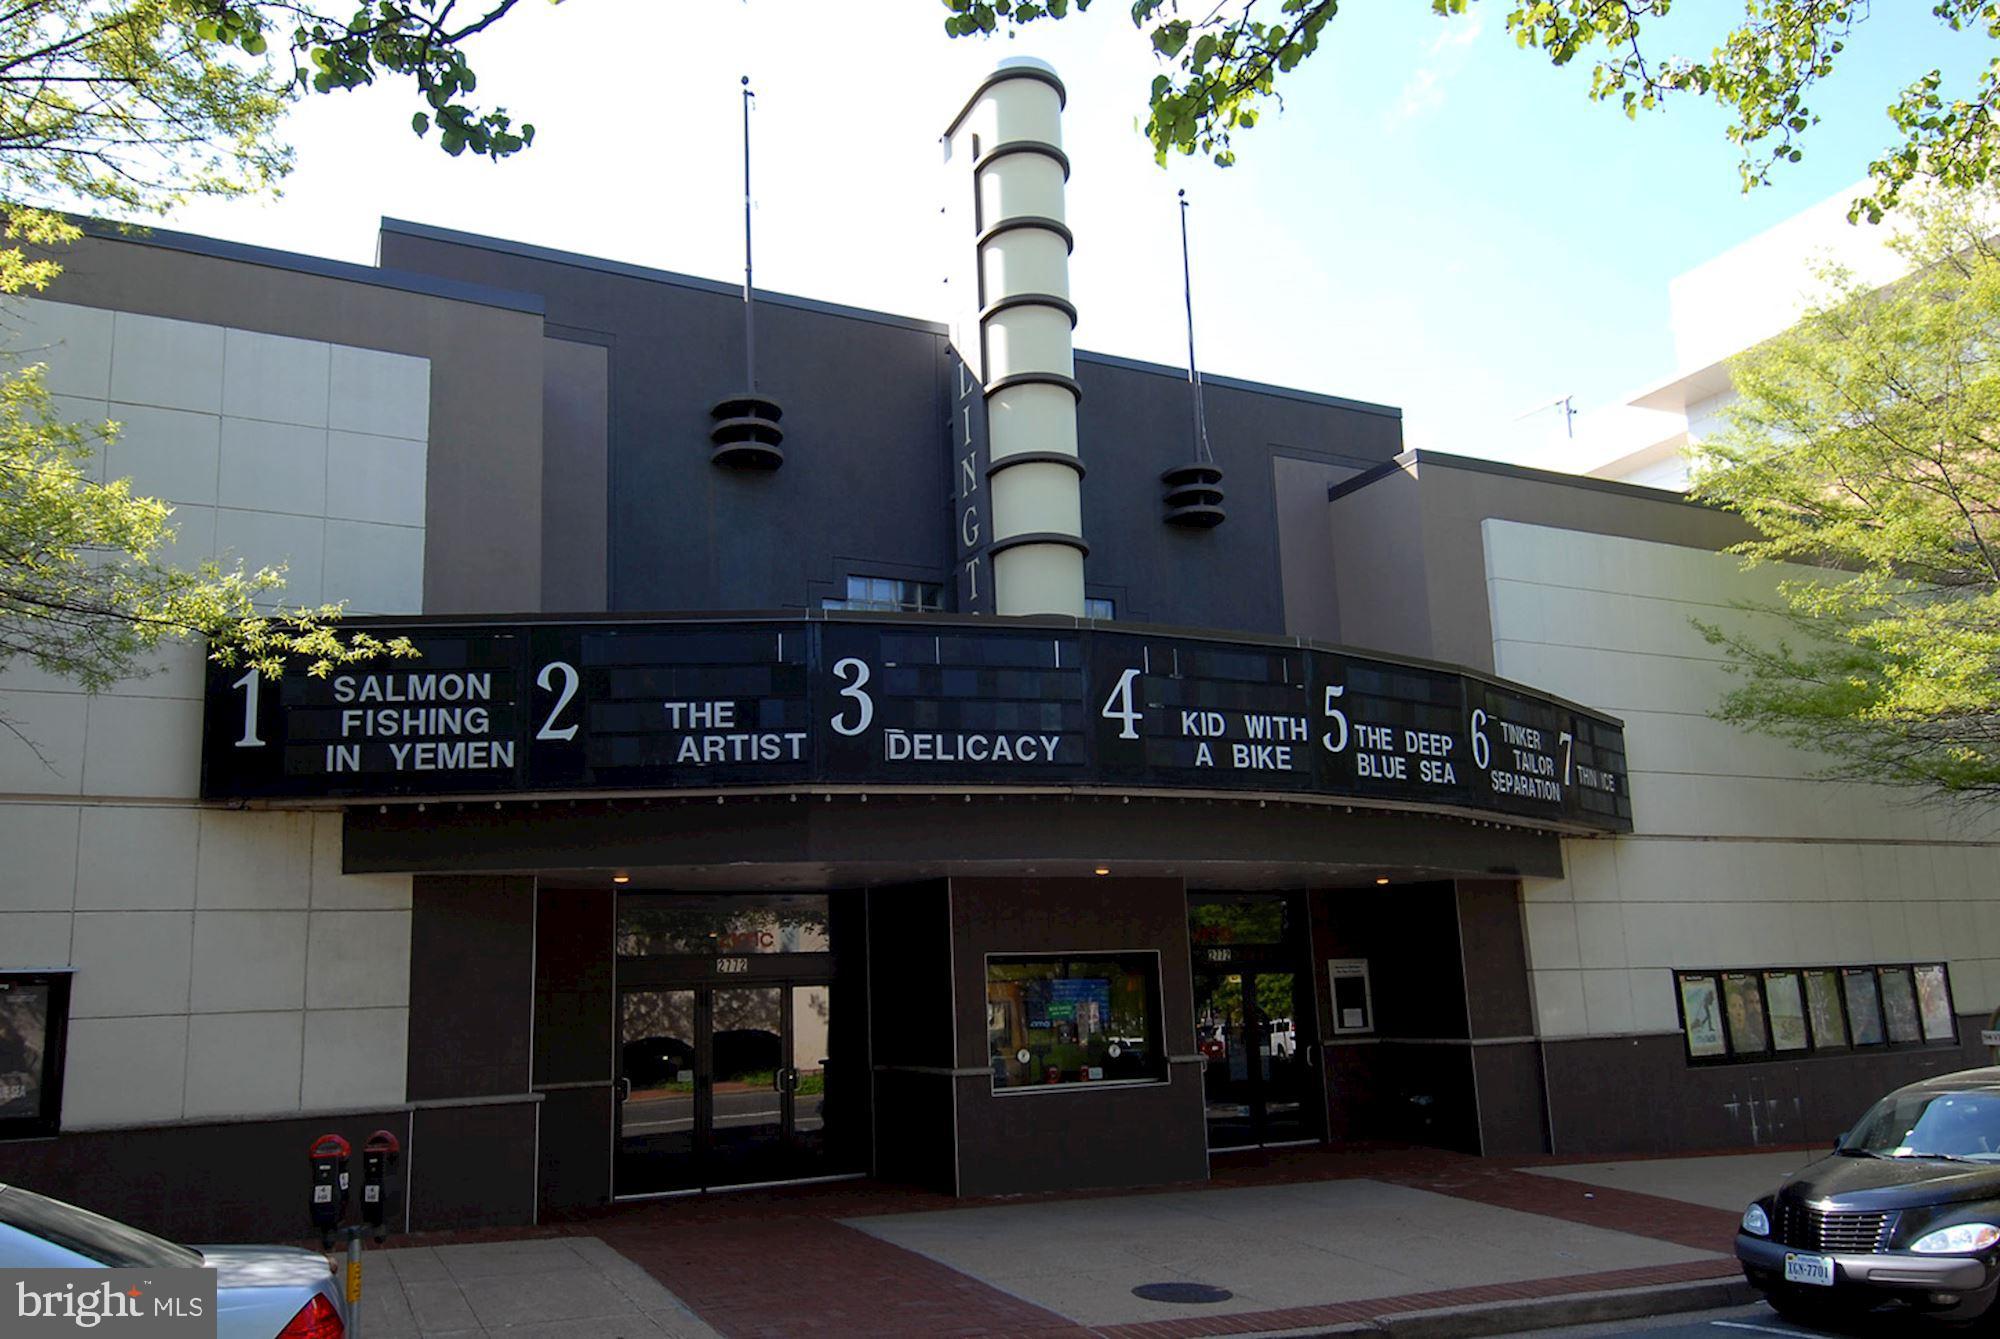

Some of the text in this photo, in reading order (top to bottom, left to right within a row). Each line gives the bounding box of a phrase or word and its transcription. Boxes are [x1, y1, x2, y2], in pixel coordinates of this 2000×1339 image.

[333, 673, 492, 704] SALMON
[535, 661, 580, 742] 2
[830, 657, 874, 736] 3
[1102, 668, 1143, 740] 4
[232, 668, 267, 748] 1
[342, 707, 490, 738] FISHING
[664, 701, 735, 730] THE
[1323, 685, 1348, 752] 5
[1181, 711, 1308, 743] KID WITH
[1354, 724, 1453, 757] THE DEEP
[1471, 708, 1490, 770] 6
[1500, 721, 1542, 751] TINKER
[326, 740, 515, 772] IN YEMEN
[677, 732, 807, 764] ARTIST
[887, 734, 1060, 762] DELICACY
[1195, 743, 1293, 771] A BIKE
[1512, 750, 1555, 776] TAILOR
[1558, 731, 1573, 786] 7
[1356, 752, 1456, 785] BLUE SEA
[1577, 765, 1598, 788] THIN
[1490, 771, 1561, 802] SEPARATION
[718, 959, 747, 973] 2772
